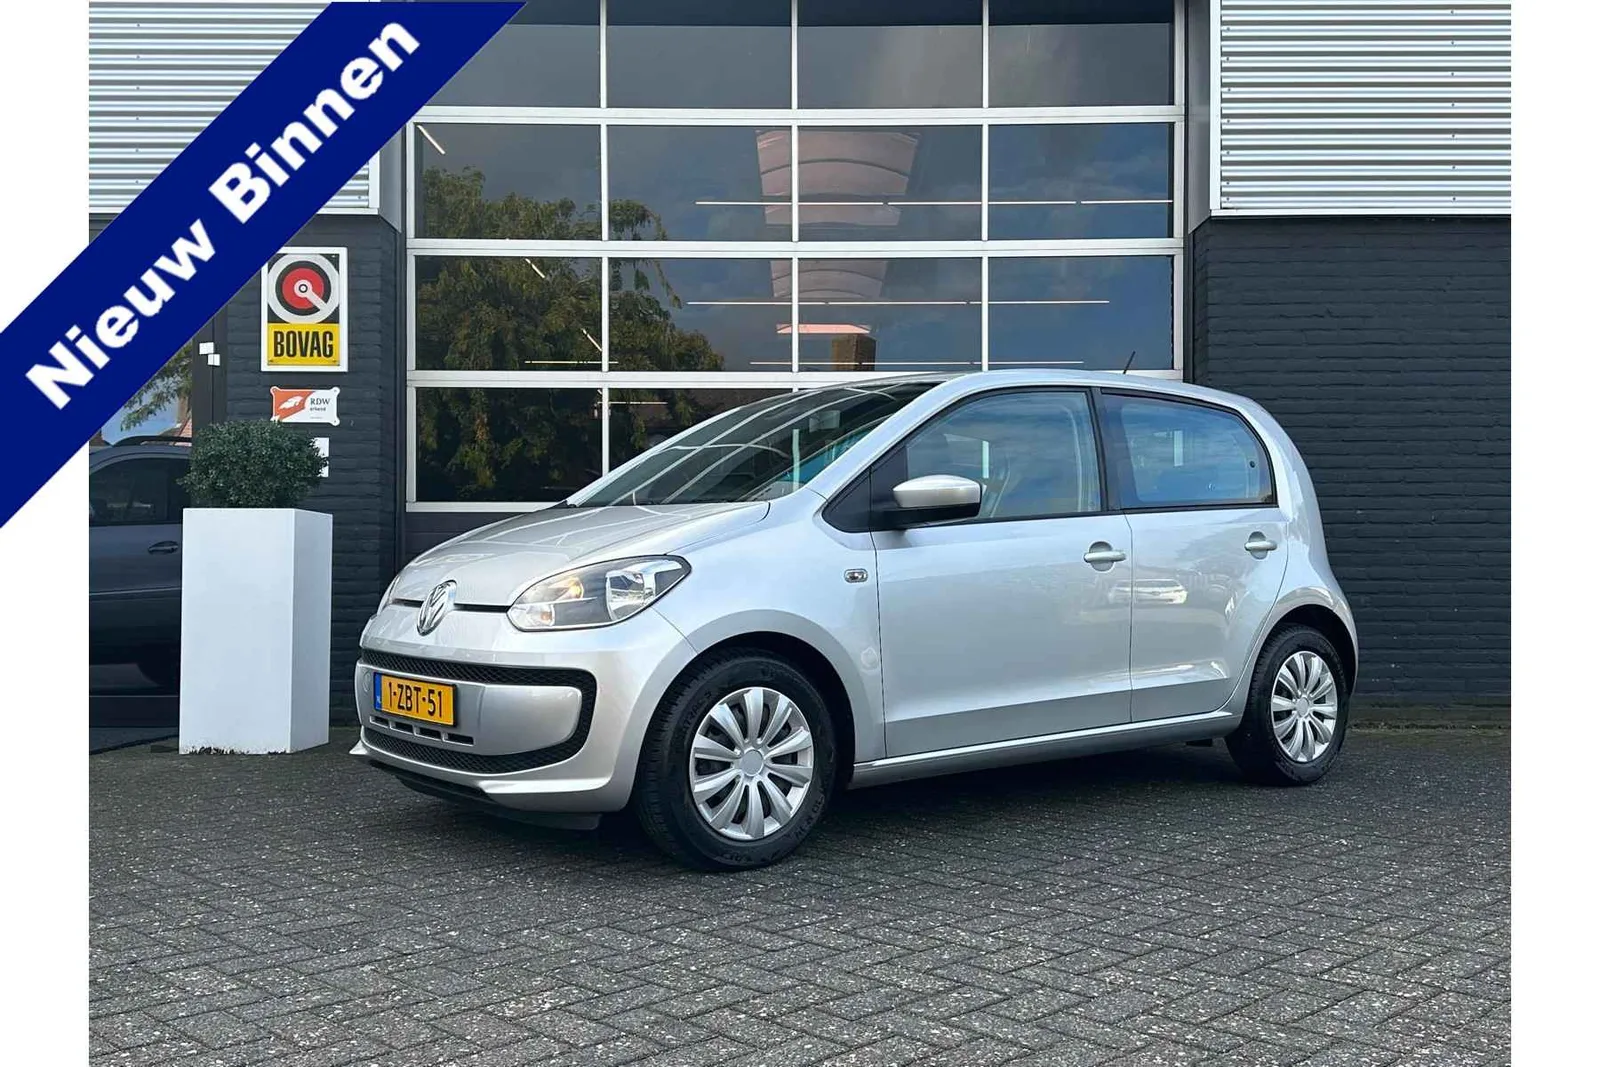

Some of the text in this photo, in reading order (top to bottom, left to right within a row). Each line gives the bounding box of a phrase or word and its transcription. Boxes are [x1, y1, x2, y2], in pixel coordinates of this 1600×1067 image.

[273, 330, 334, 358] BOVAG
[309, 397, 331, 405] RDW
[388, 681, 443, 719] 1-ZBT-51
